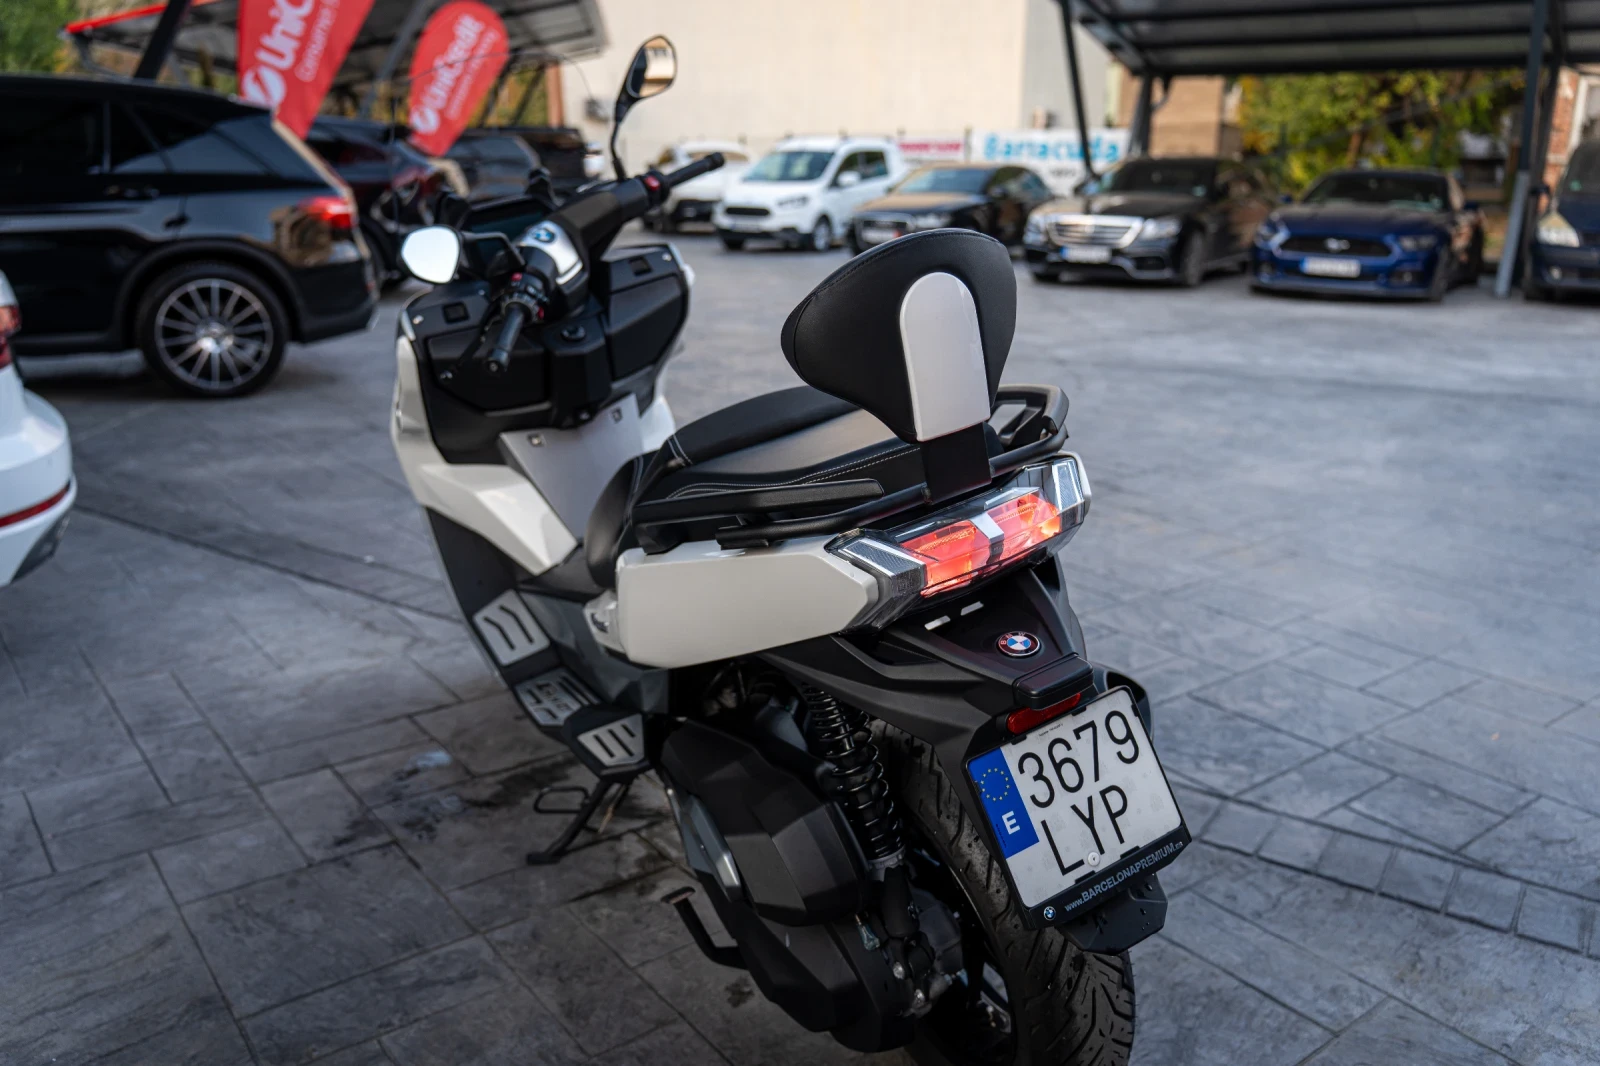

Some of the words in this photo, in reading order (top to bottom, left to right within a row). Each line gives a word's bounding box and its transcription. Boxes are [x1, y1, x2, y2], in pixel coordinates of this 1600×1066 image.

[1018, 711, 1139, 808] 3679
[1001, 811, 1020, 835] E
[1041, 785, 1127, 875] LYP
